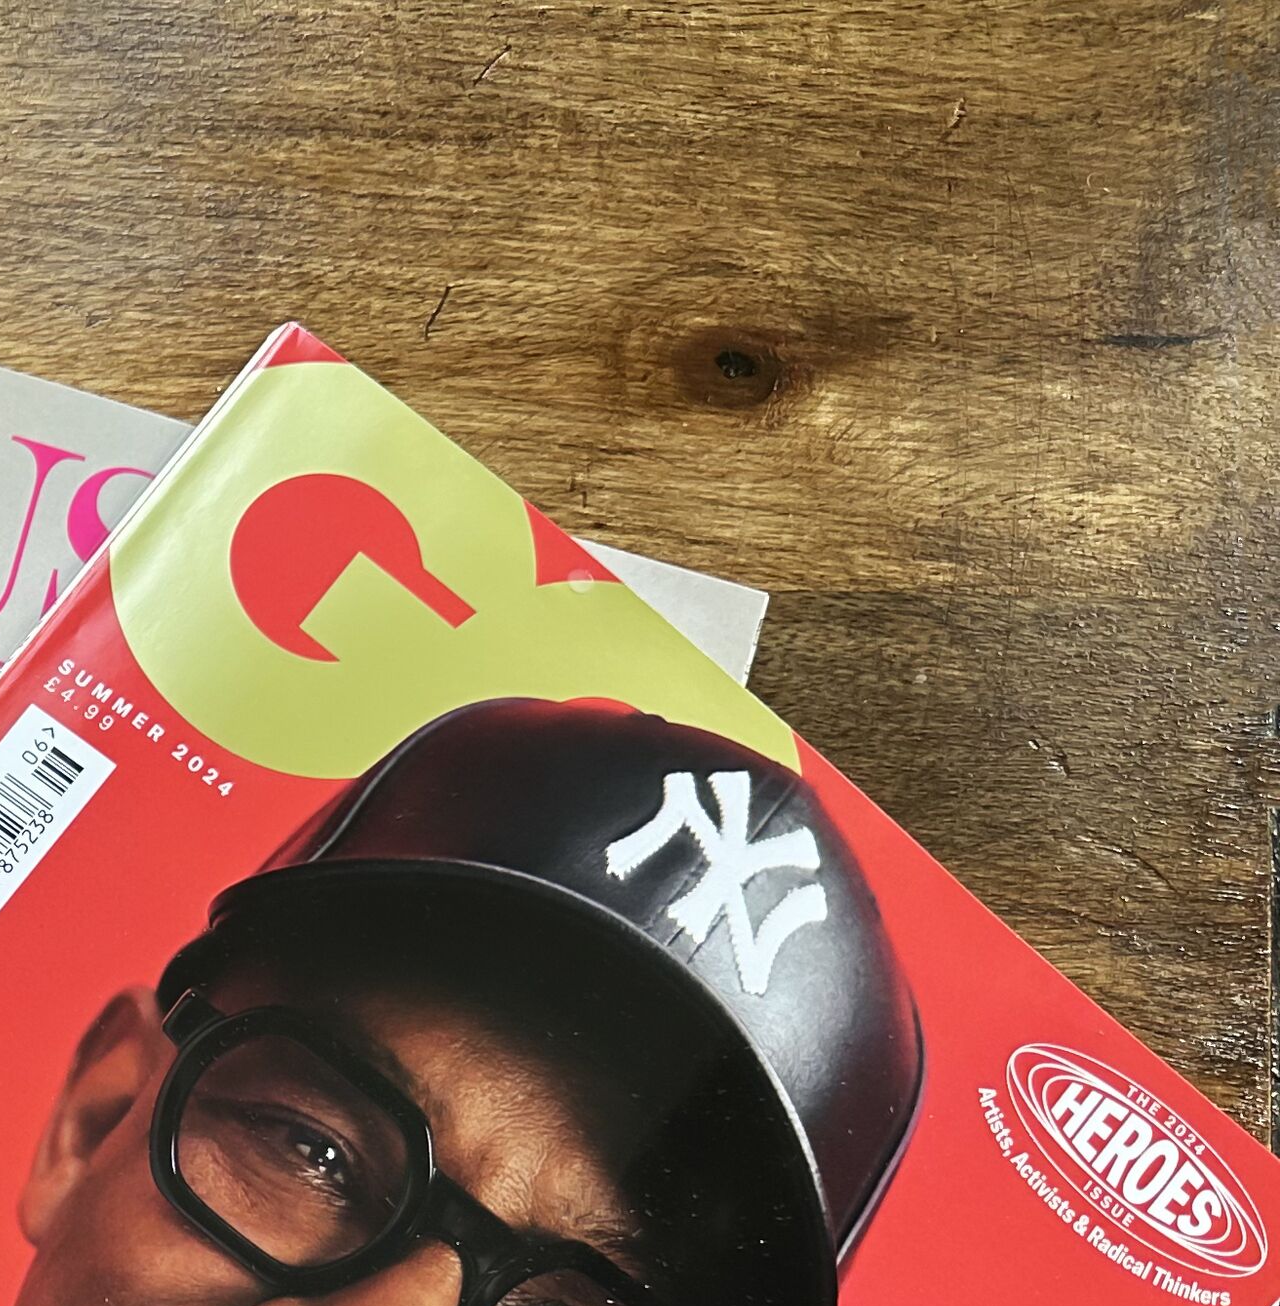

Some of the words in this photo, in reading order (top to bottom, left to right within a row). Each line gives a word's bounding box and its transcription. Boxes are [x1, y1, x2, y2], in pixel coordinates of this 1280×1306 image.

[43, 676, 116, 732] £4.99
[58, 657, 166, 743] SUMMER
[170, 743, 235, 797] 2024
[1052, 1082, 1222, 1237] HEROES
[1126, 1084, 1160, 1116] THE
[1166, 1114, 1207, 1156] 2024
[977, 1087, 1015, 1157] Artists,
[1010, 1152, 1075, 1224] Activists
[1072, 1215, 1090, 1237] &
[1086, 1225, 1153, 1280] Radical
[1152, 1266, 1231, 1306] Thinkers
[1082, 1180, 1136, 1228] ISSUE
